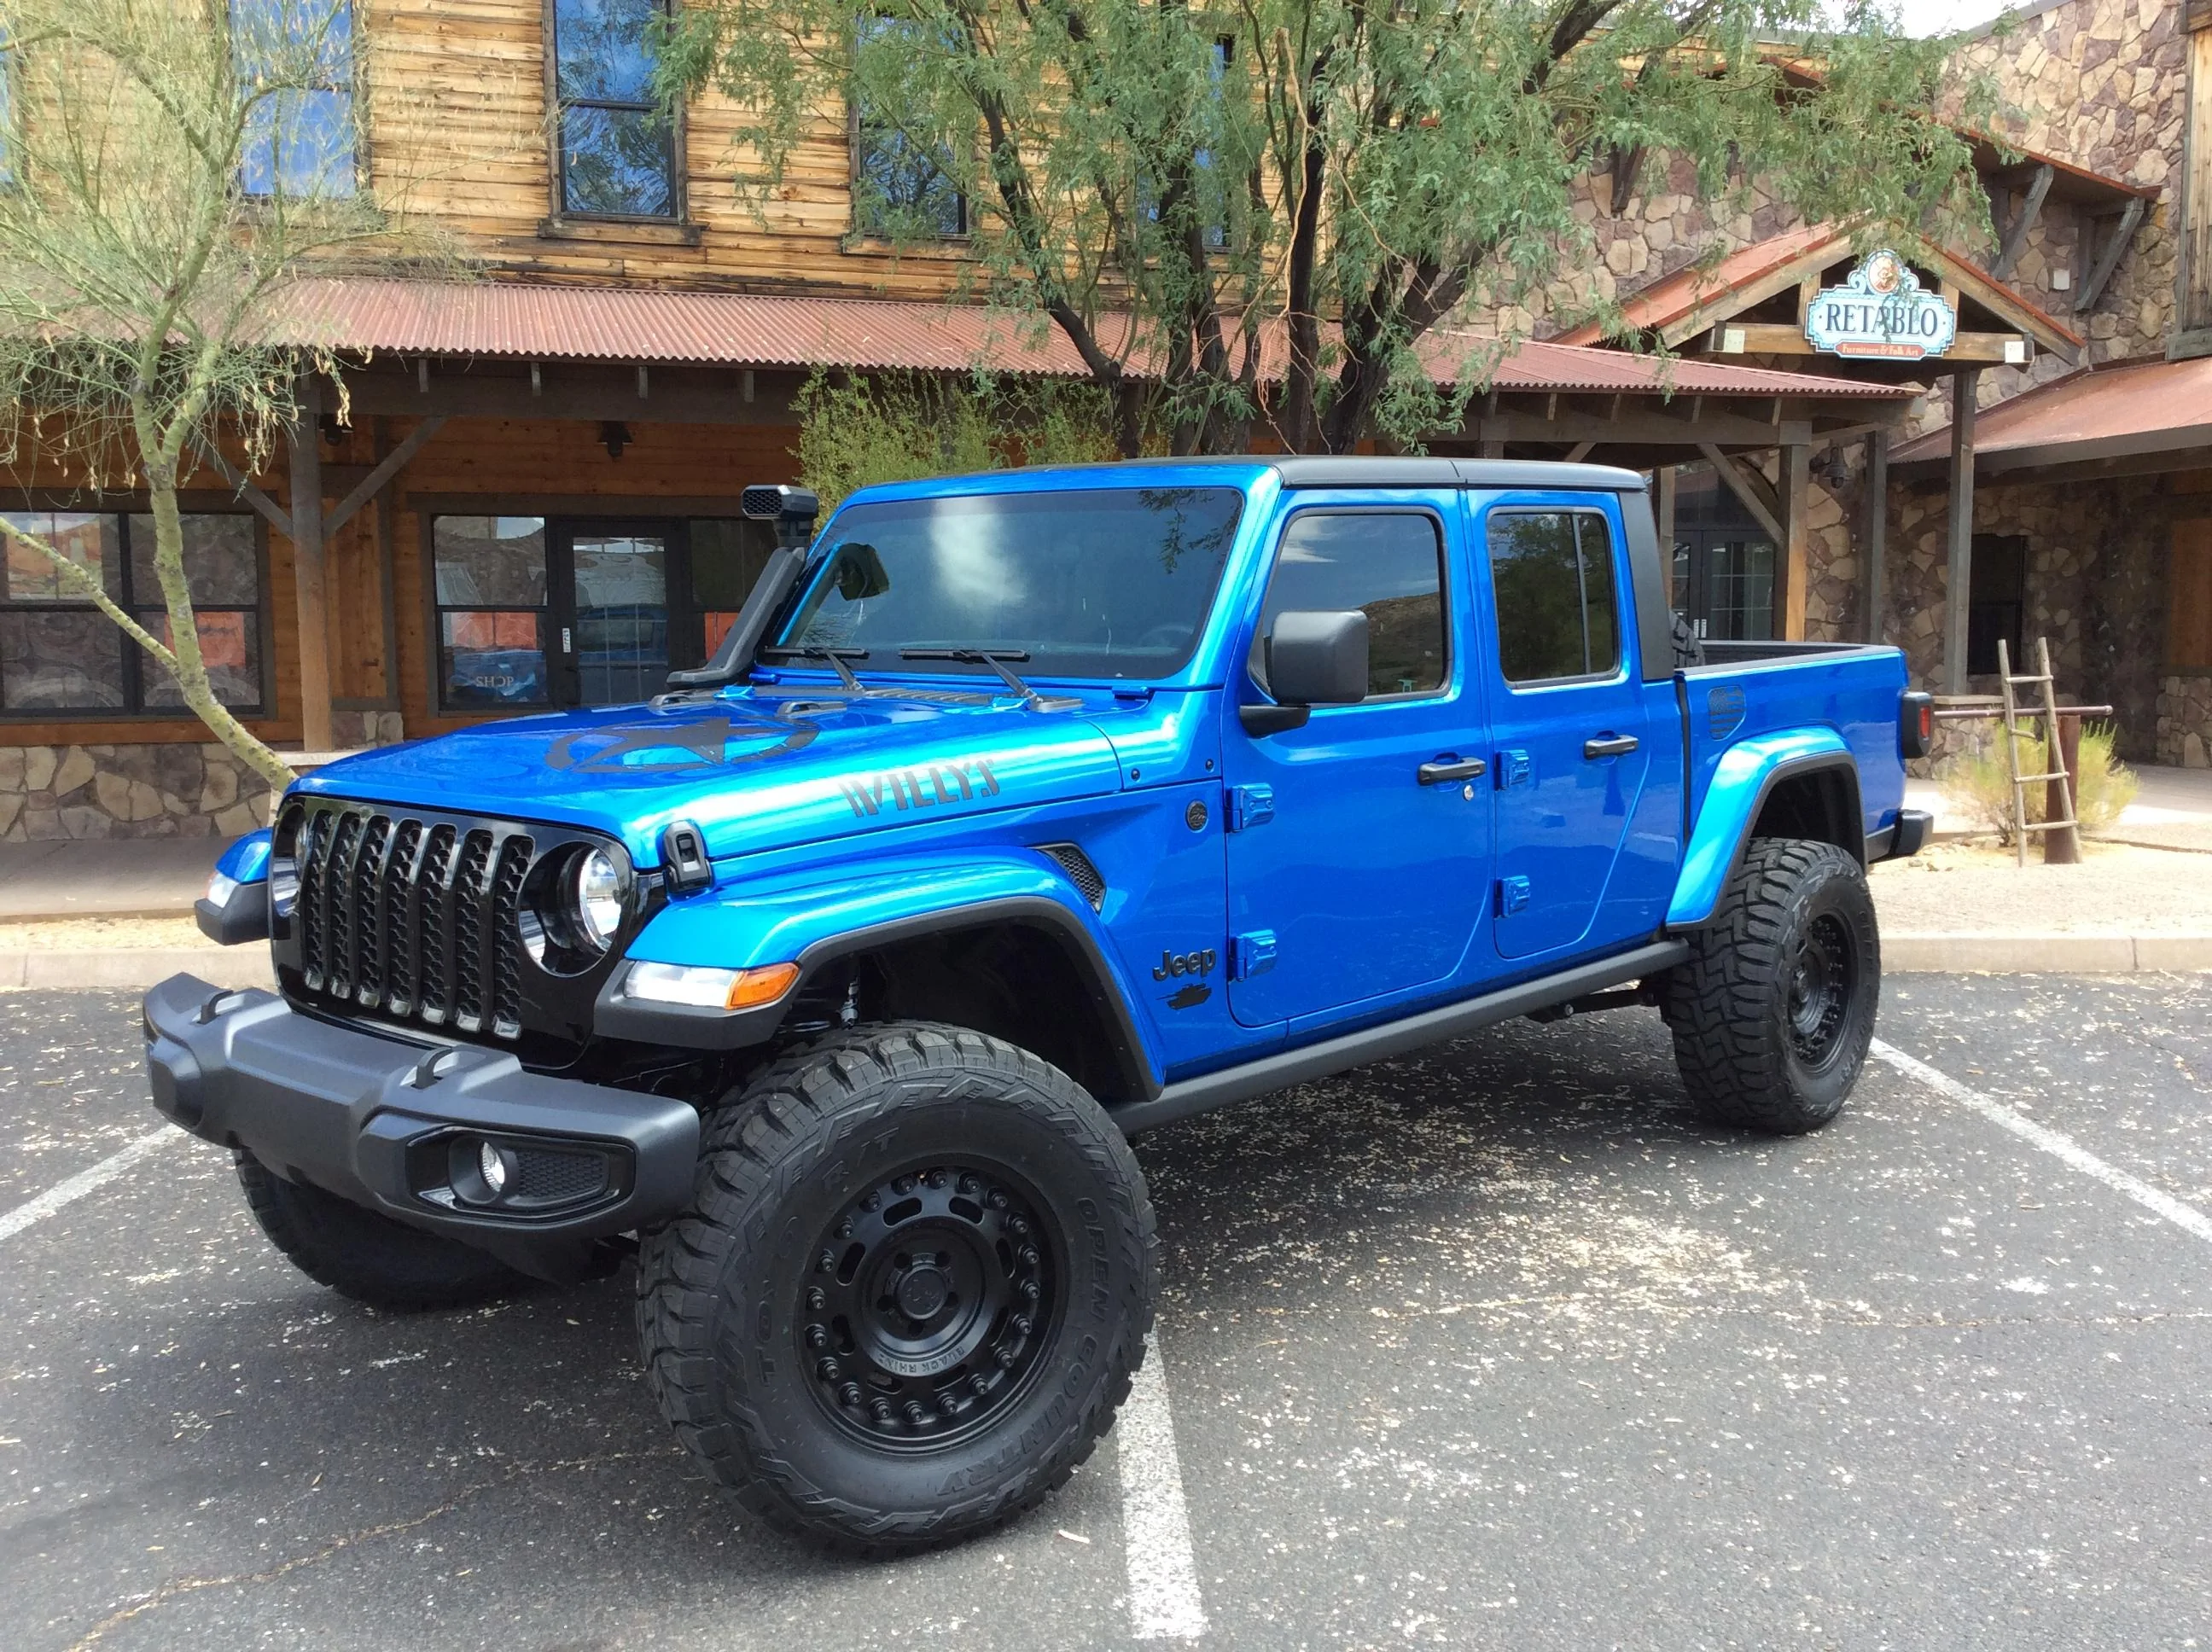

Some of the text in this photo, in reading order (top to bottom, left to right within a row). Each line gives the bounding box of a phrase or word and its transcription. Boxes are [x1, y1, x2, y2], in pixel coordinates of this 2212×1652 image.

[1825, 303, 1937, 336] RETABLO
[1842, 344, 1879, 354] Furniture
[1905, 347, 1918, 356] Art
[476, 676, 514, 687] SHOP
[838, 759, 1000, 817] WILLYS
[1153, 949, 1216, 981] Jeep
[922, 1346, 965, 1371] BLACK
[938, 1197, 1110, 1497] OPEN COUNTRY
